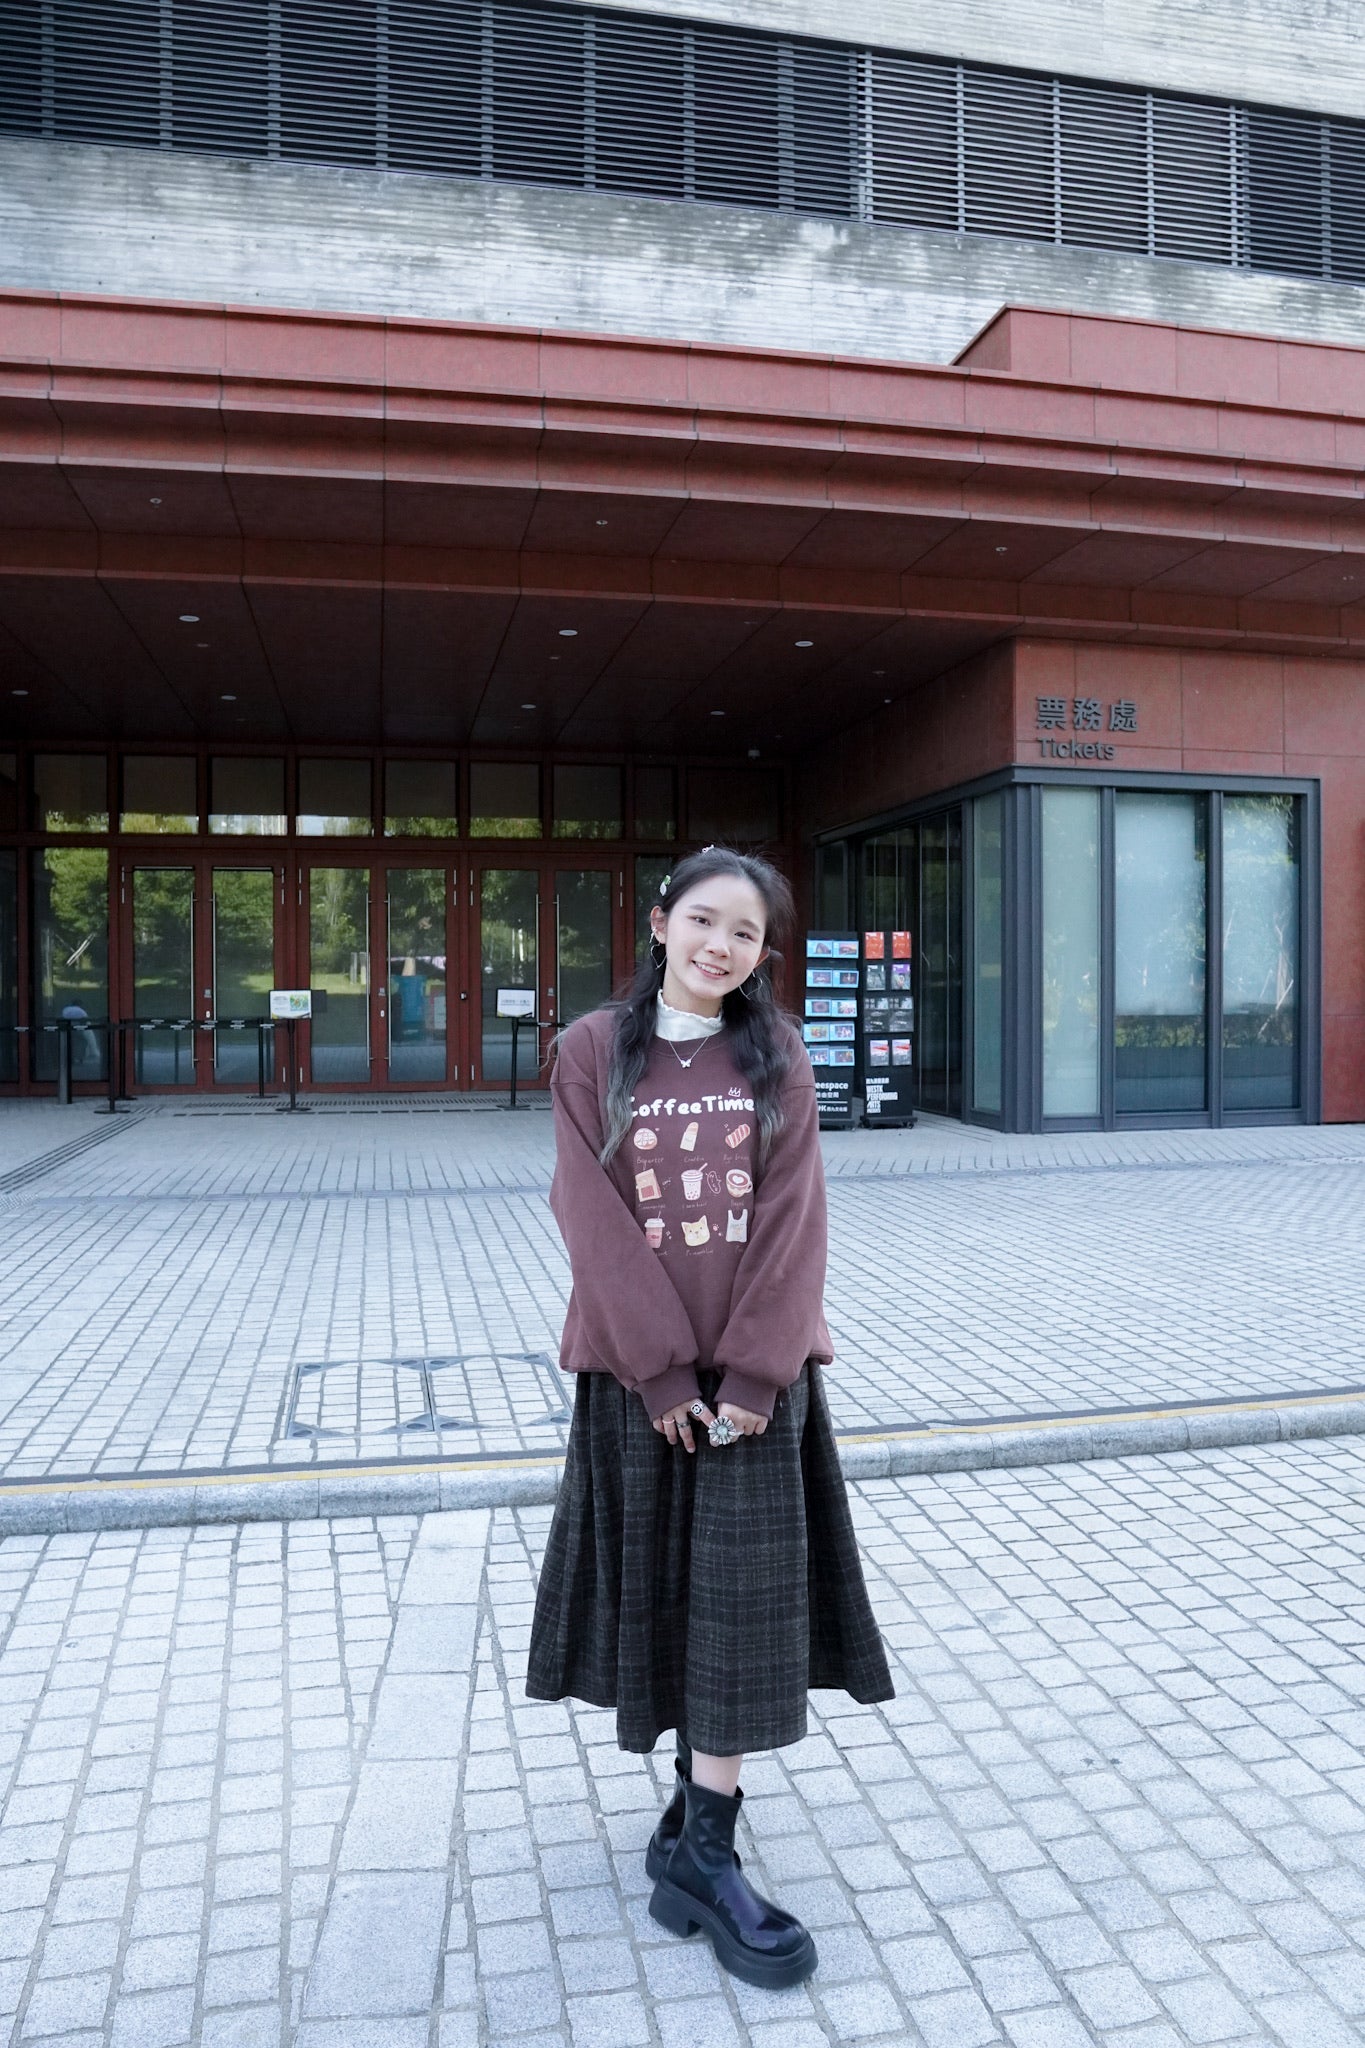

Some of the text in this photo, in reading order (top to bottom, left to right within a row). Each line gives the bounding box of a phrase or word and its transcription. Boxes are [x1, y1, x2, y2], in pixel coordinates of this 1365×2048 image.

[1036, 696, 1138, 732] 票務處
[1037, 737, 1117, 760] Tickets
[815, 1082, 849, 1091] eespace
